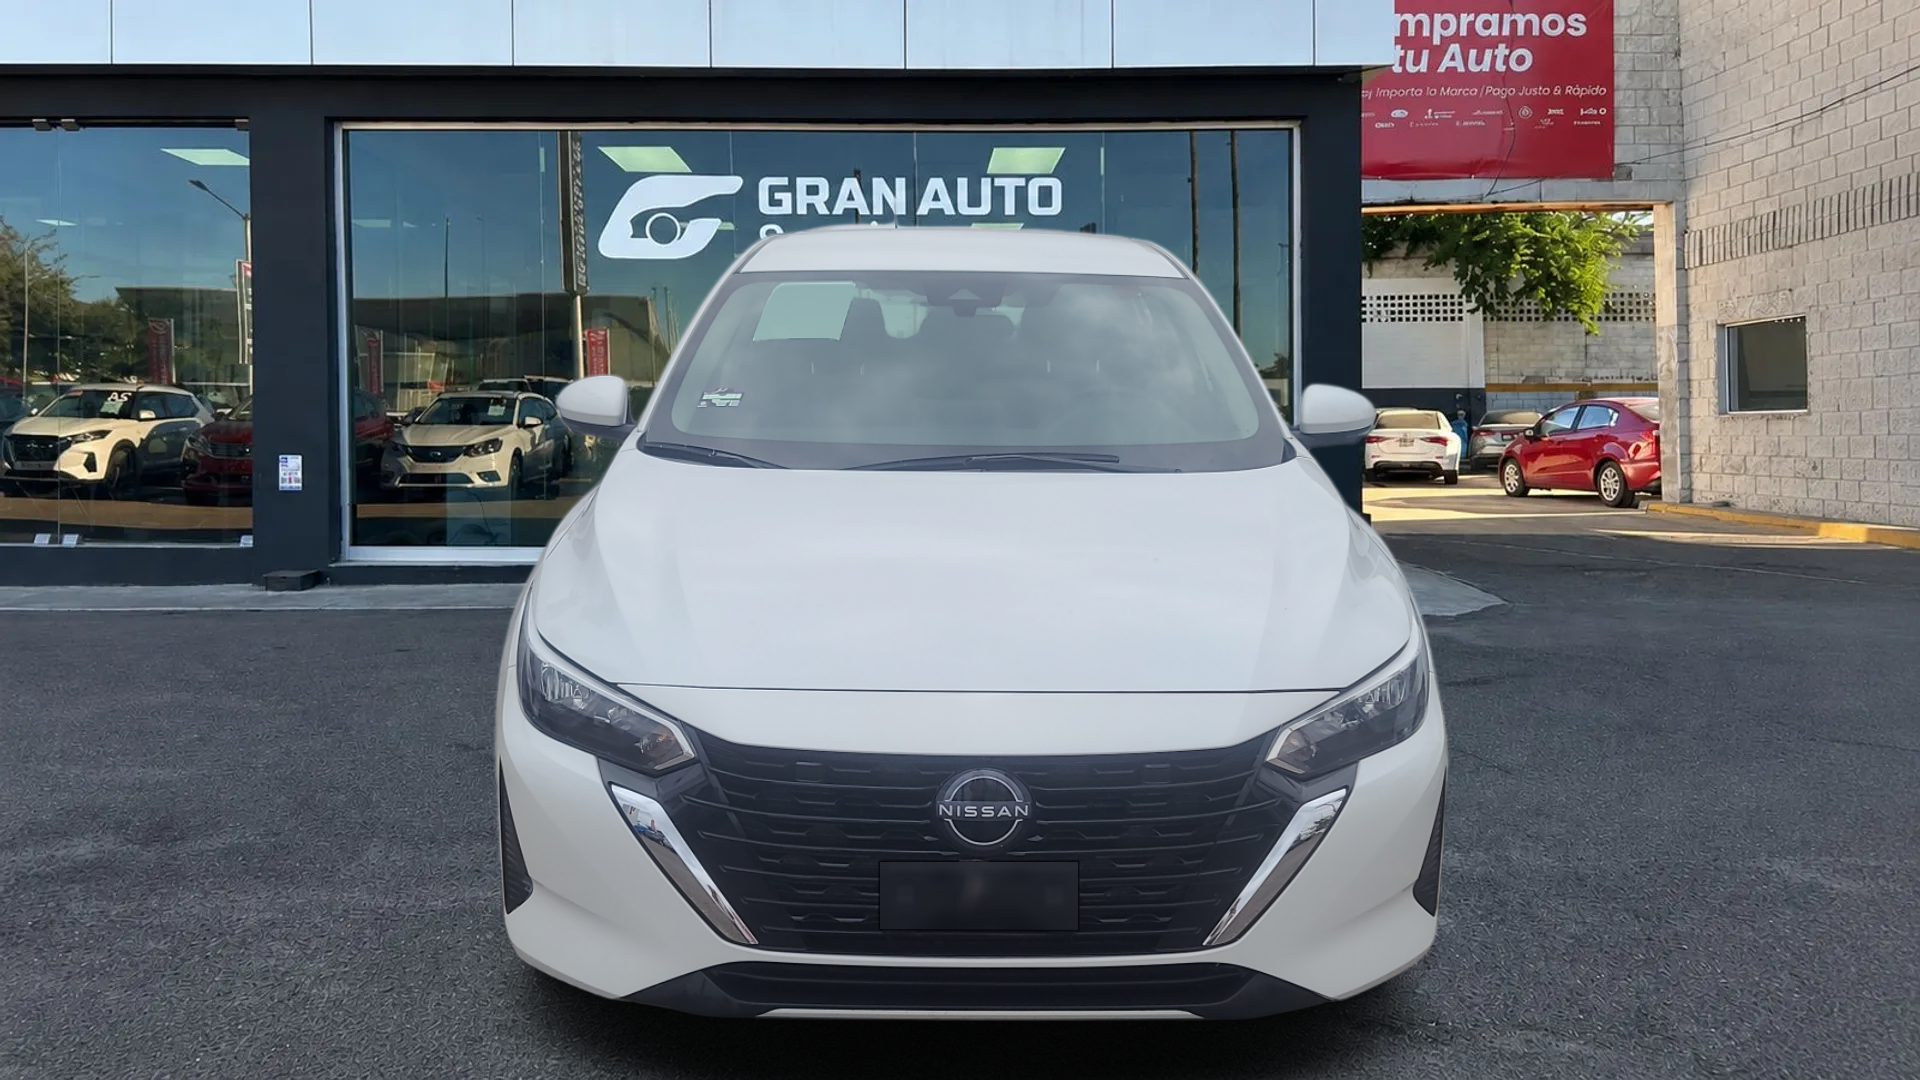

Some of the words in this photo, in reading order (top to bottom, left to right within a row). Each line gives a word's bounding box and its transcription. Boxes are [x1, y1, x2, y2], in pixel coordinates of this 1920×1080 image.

[1394, 12, 1587, 46] mpramos
[1392, 43, 1430, 74] tu
[1437, 42, 1533, 73] Auto
[1375, 87, 1423, 99] Importa
[1426, 86, 1437, 97] la
[1440, 86, 1478, 97] Marca
[1518, 85, 1551, 96] Justo
[1553, 85, 1562, 96] &
[758, 176, 906, 215] GRAN
[916, 176, 1062, 215] AUTO
[938, 803, 1029, 818] NISSAN
